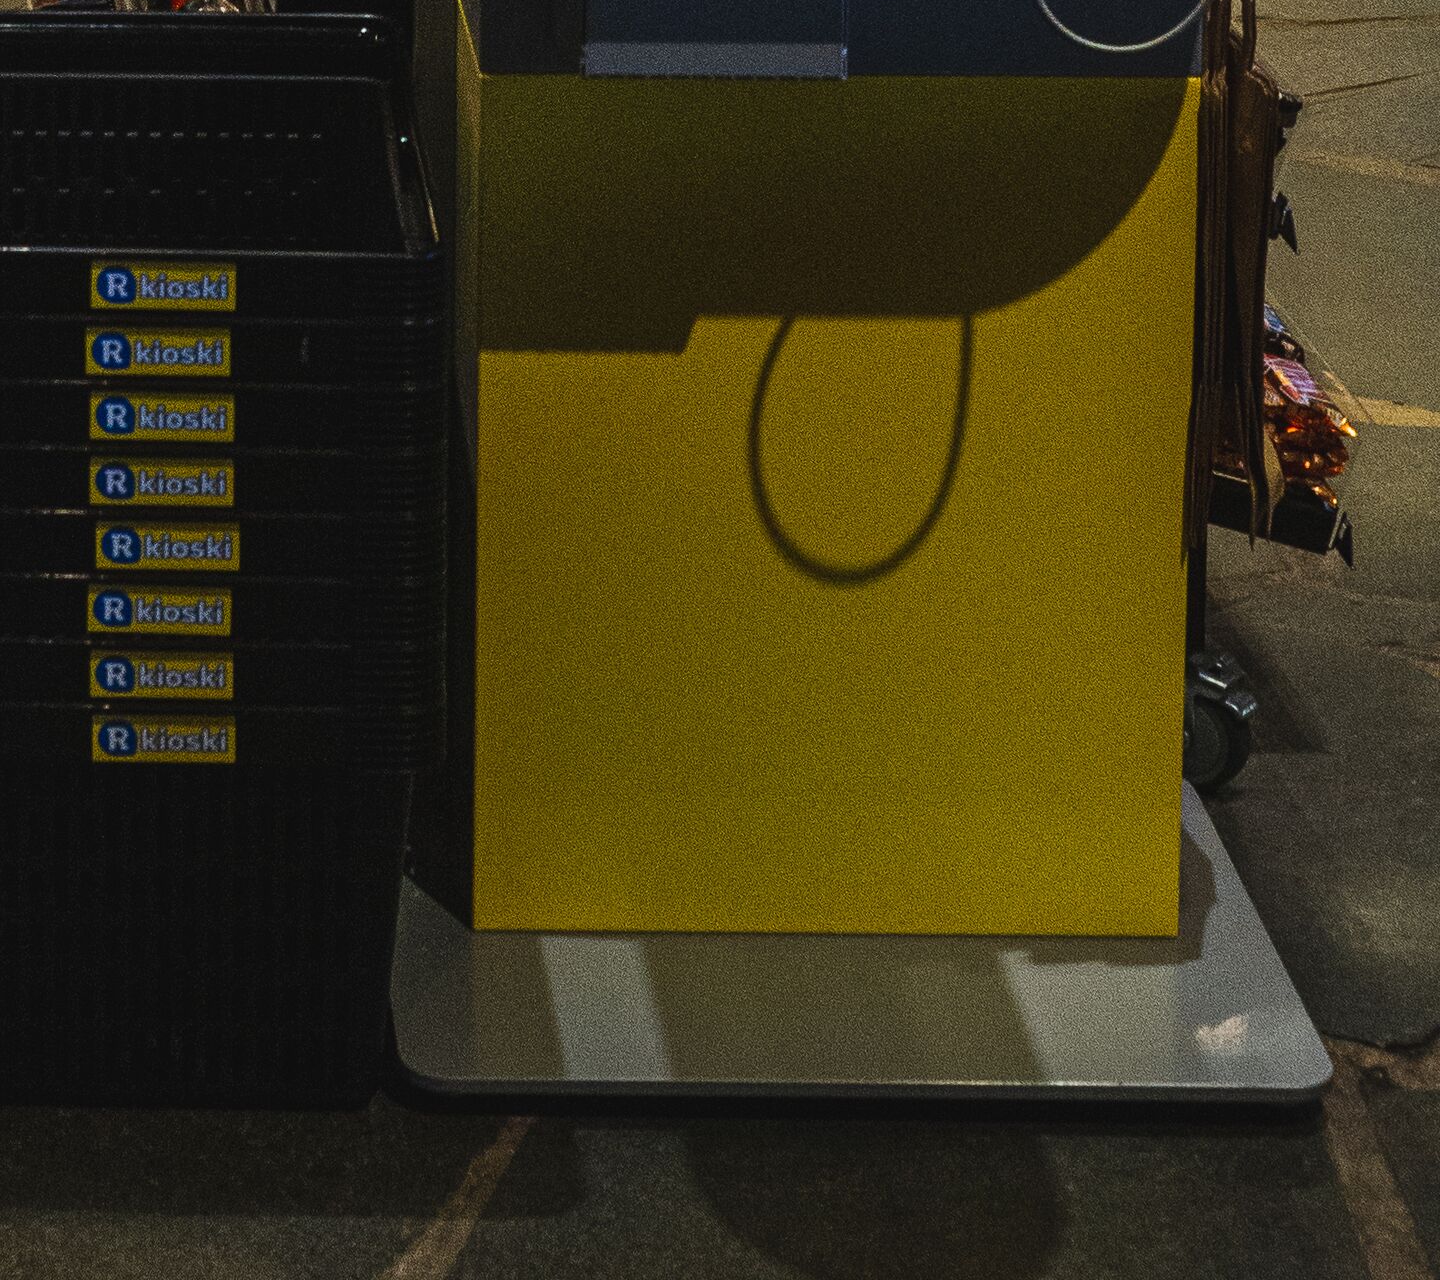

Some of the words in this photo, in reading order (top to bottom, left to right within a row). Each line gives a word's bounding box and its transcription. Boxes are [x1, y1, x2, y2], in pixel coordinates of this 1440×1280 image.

[140, 272, 228, 300] kioski
[135, 339, 223, 365] kioski
[139, 405, 226, 431] kioski
[139, 469, 226, 496] kioski
[145, 533, 232, 560] kioski
[136, 597, 224, 625] kioski
[138, 662, 226, 689] kioski
[141, 727, 228, 753] kioski
